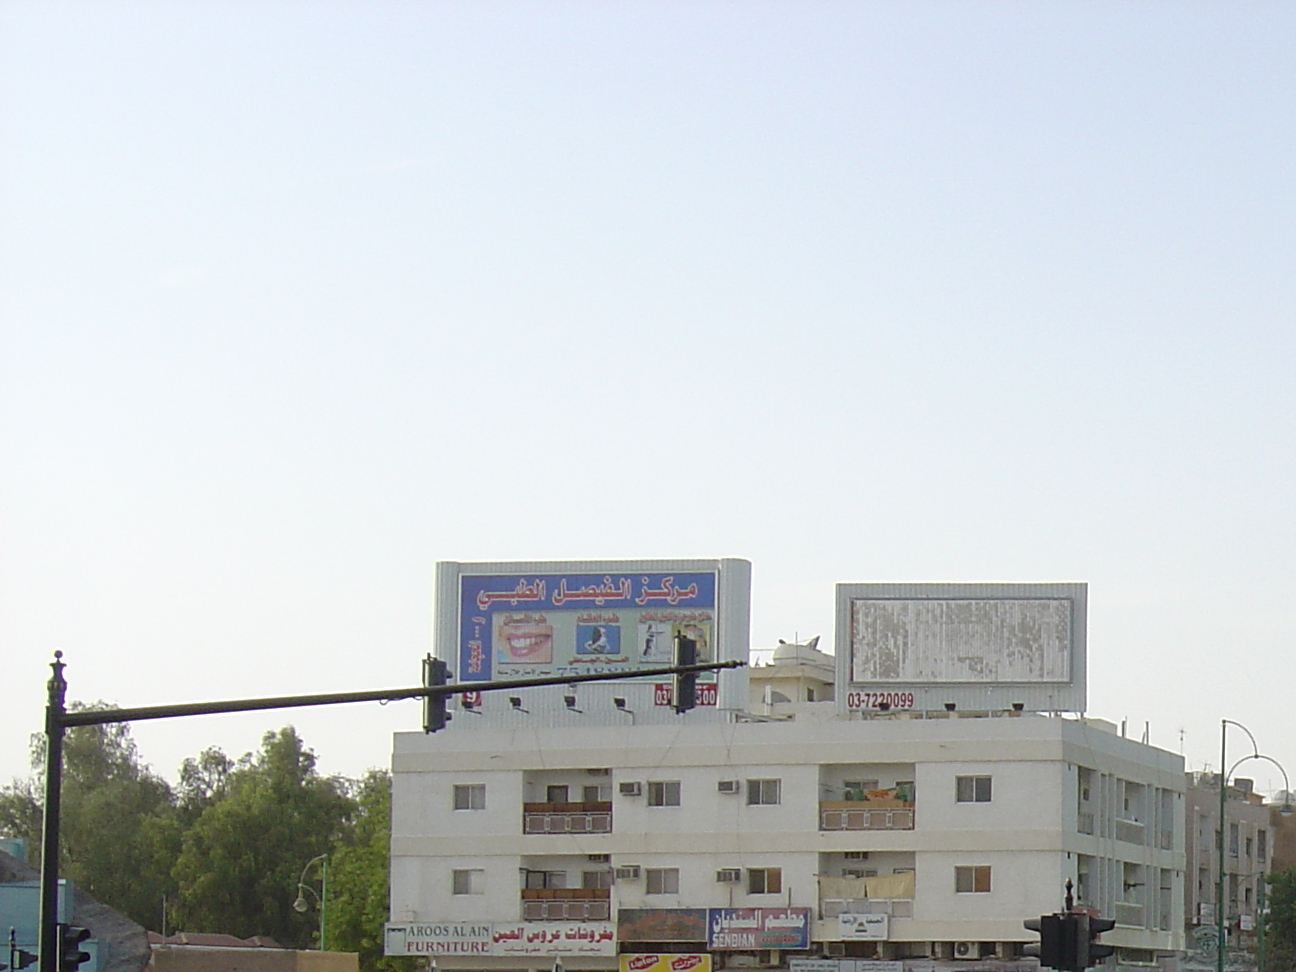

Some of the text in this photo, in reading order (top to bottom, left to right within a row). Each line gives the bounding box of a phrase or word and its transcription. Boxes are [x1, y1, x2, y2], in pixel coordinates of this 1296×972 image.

[477, 575, 698, 611] مركز الفيصل الطبي
[712, 909, 805, 933] مطعم السنديان
[408, 926, 449, 937] AROOS
[493, 926, 614, 943] مفروشات عروس العين
[407, 941, 489, 952] FURNITURE
[629, 956, 658, 969] Lipton
